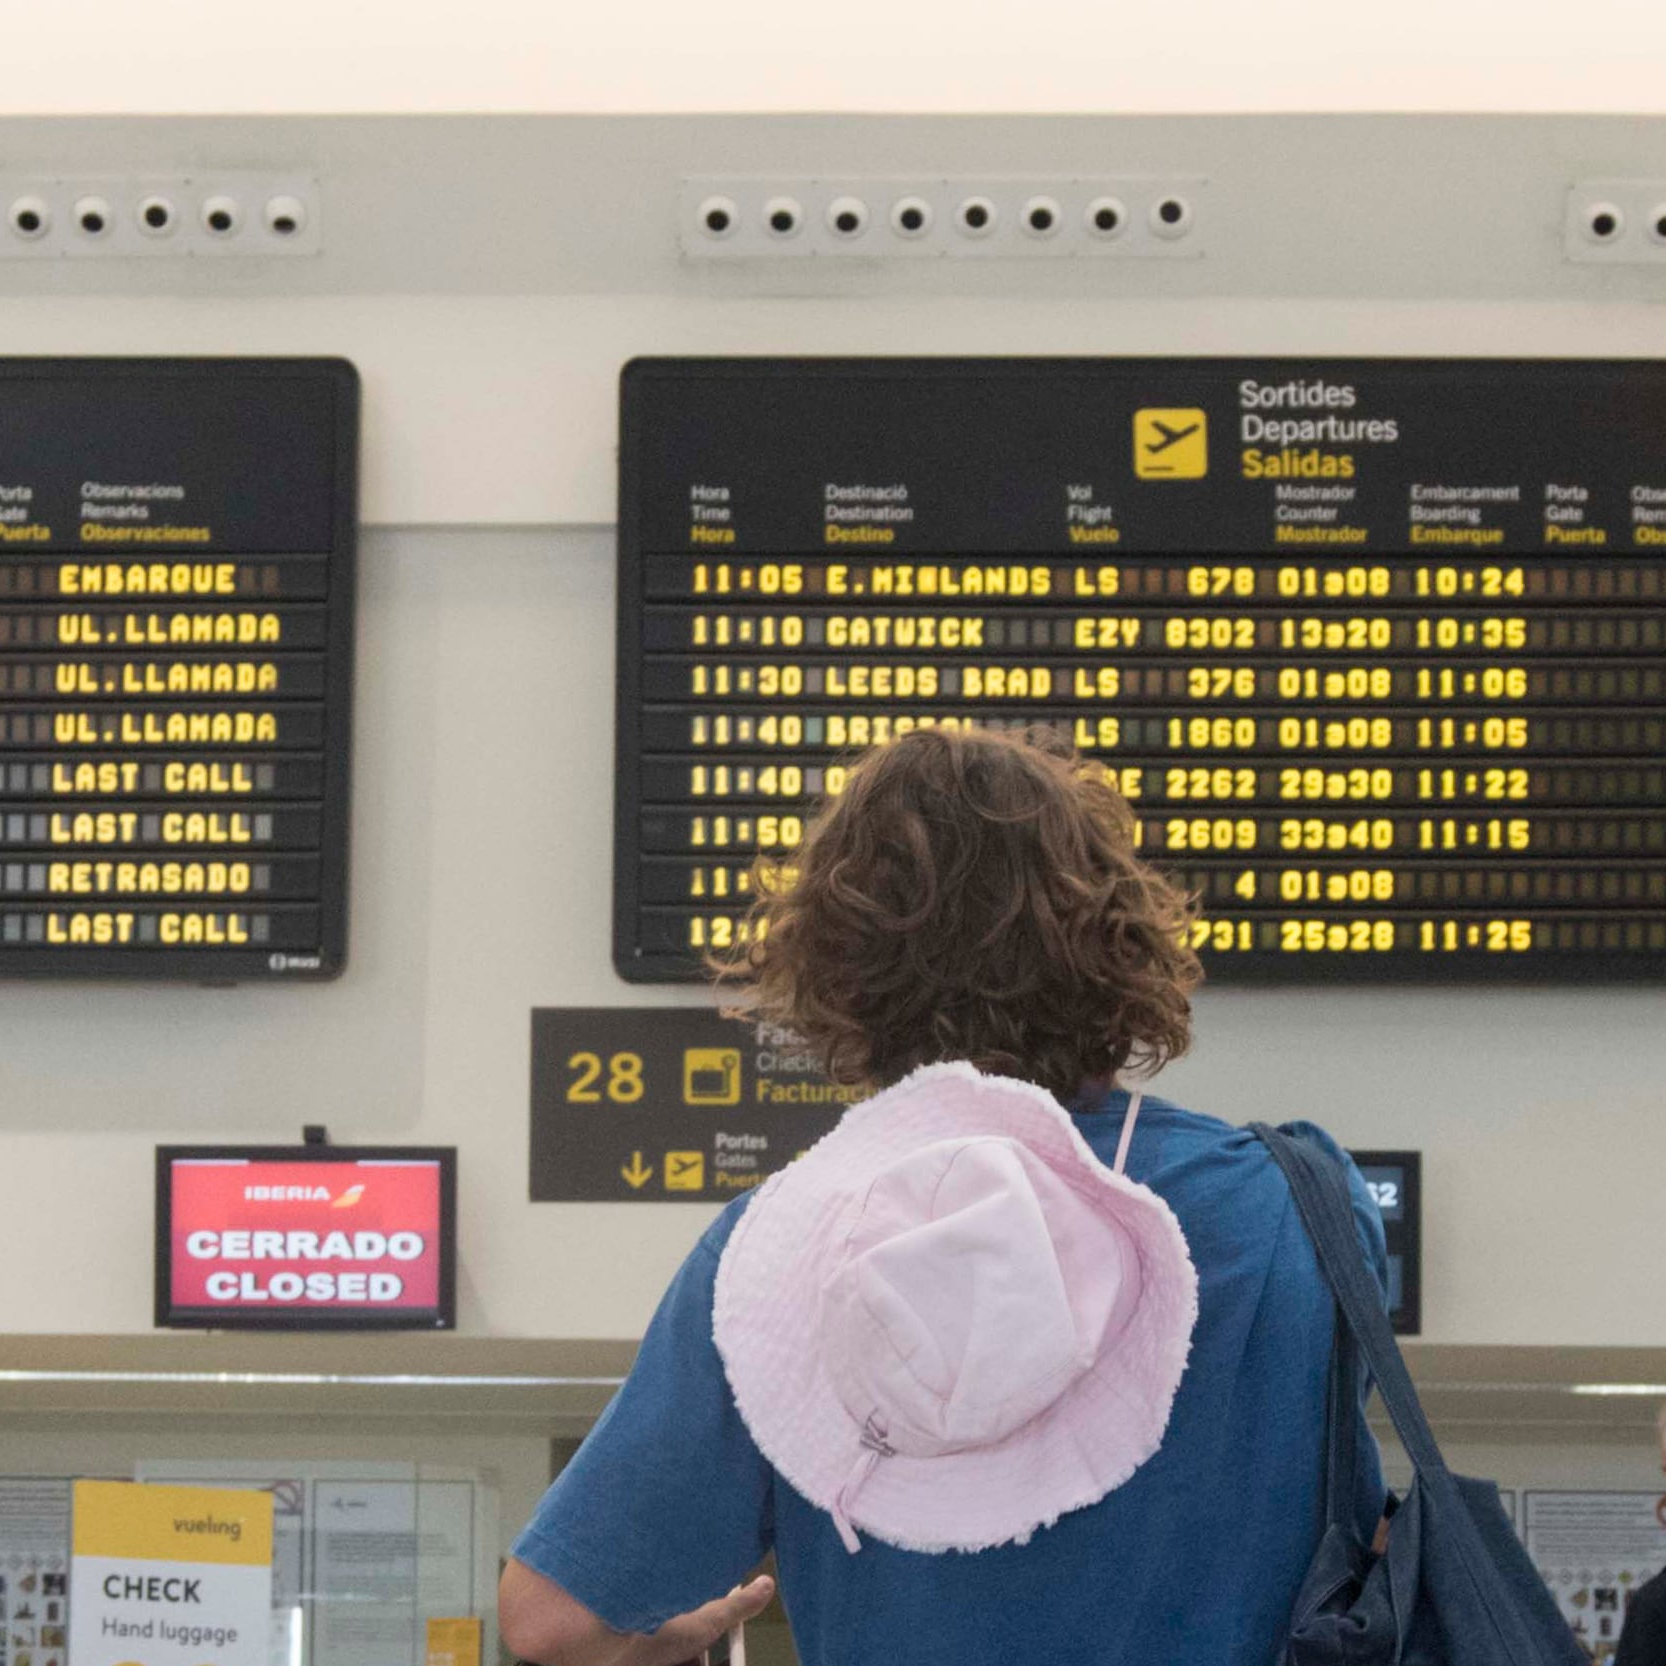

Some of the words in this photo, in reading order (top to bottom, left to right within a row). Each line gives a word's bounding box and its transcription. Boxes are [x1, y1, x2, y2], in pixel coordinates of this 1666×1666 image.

[1240, 378, 1357, 407] Sortides
[1242, 415, 1399, 447] Departures
[1242, 449, 1355, 478] Salidas
[691, 485, 730, 501] Hora
[824, 484, 908, 501] Destinació
[1067, 485, 1092, 501] Vol
[1275, 484, 1357, 501] Mostrador
[1410, 484, 1521, 502] Embarcament
[1546, 484, 1589, 502] Porta
[691, 505, 731, 521] Time
[824, 505, 914, 522] Destination
[1067, 505, 1113, 524] Flight
[1275, 505, 1338, 522] Counter
[1410, 504, 1482, 525] Boarding
[1546, 505, 1584, 522] Gate
[690, 526, 735, 543] Hora
[824, 526, 895, 543] Destino
[1069, 526, 1120, 543] Vuelo
[1275, 525, 1368, 544] Mostrador
[1410, 526, 1504, 547] Embarque
[1545, 526, 1607, 545] Puerta
[60, 564, 235, 593] EMBARQUE
[695, 565, 802, 593] 11:05
[1075, 567, 1118, 595] LS
[1188, 567, 1254, 595] 678
[1417, 568, 1524, 596] 10:24
[59, 614, 279, 643] UL.LLAMADA
[694, 616, 802, 645] 11:10
[827, 617, 983, 647] GATWICK
[1075, 618, 1140, 647] EZY
[1166, 619, 1254, 648] 8302
[1418, 619, 1525, 648] 10:35
[694, 666, 802, 695] 11:30
[826, 667, 937, 696] LEEDS
[963, 667, 1051, 697] BRAD
[1075, 668, 1119, 697] LS
[1189, 668, 1255, 697] 376
[1418, 669, 1526, 697] 11:06
[55, 713, 275, 742] UL.LLAMADA
[694, 716, 801, 745] 11:40
[1074, 718, 1119, 748] LS
[1169, 718, 1255, 747] 1860
[1419, 718, 1527, 747] 11:05
[53, 763, 138, 792] LAST
[165, 763, 251, 792] CALL
[693, 767, 801, 796] 11:40
[1167, 769, 1255, 798] 2262
[1419, 770, 1528, 798] 11:22
[51, 813, 136, 843] LAST
[163, 813, 250, 842] CALL
[692, 817, 803, 848] 11:50
[1167, 820, 1256, 849] 2609
[1421, 820, 1529, 849] 11:15
[49, 863, 249, 892] RETRASADO
[48, 914, 133, 943] LAST
[160, 914, 247, 943] CALL
[566, 1052, 645, 1103] 28
[244, 1185, 331, 1202] IBERIA
[186, 1231, 424, 1260] CERRADO
[206, 1272, 404, 1301] CLOSED
[172, 1514, 242, 1543] vueling
[102, 1574, 202, 1604] CHECK
[102, 1616, 154, 1639] Hand
[160, 1619, 238, 1647] luggage
